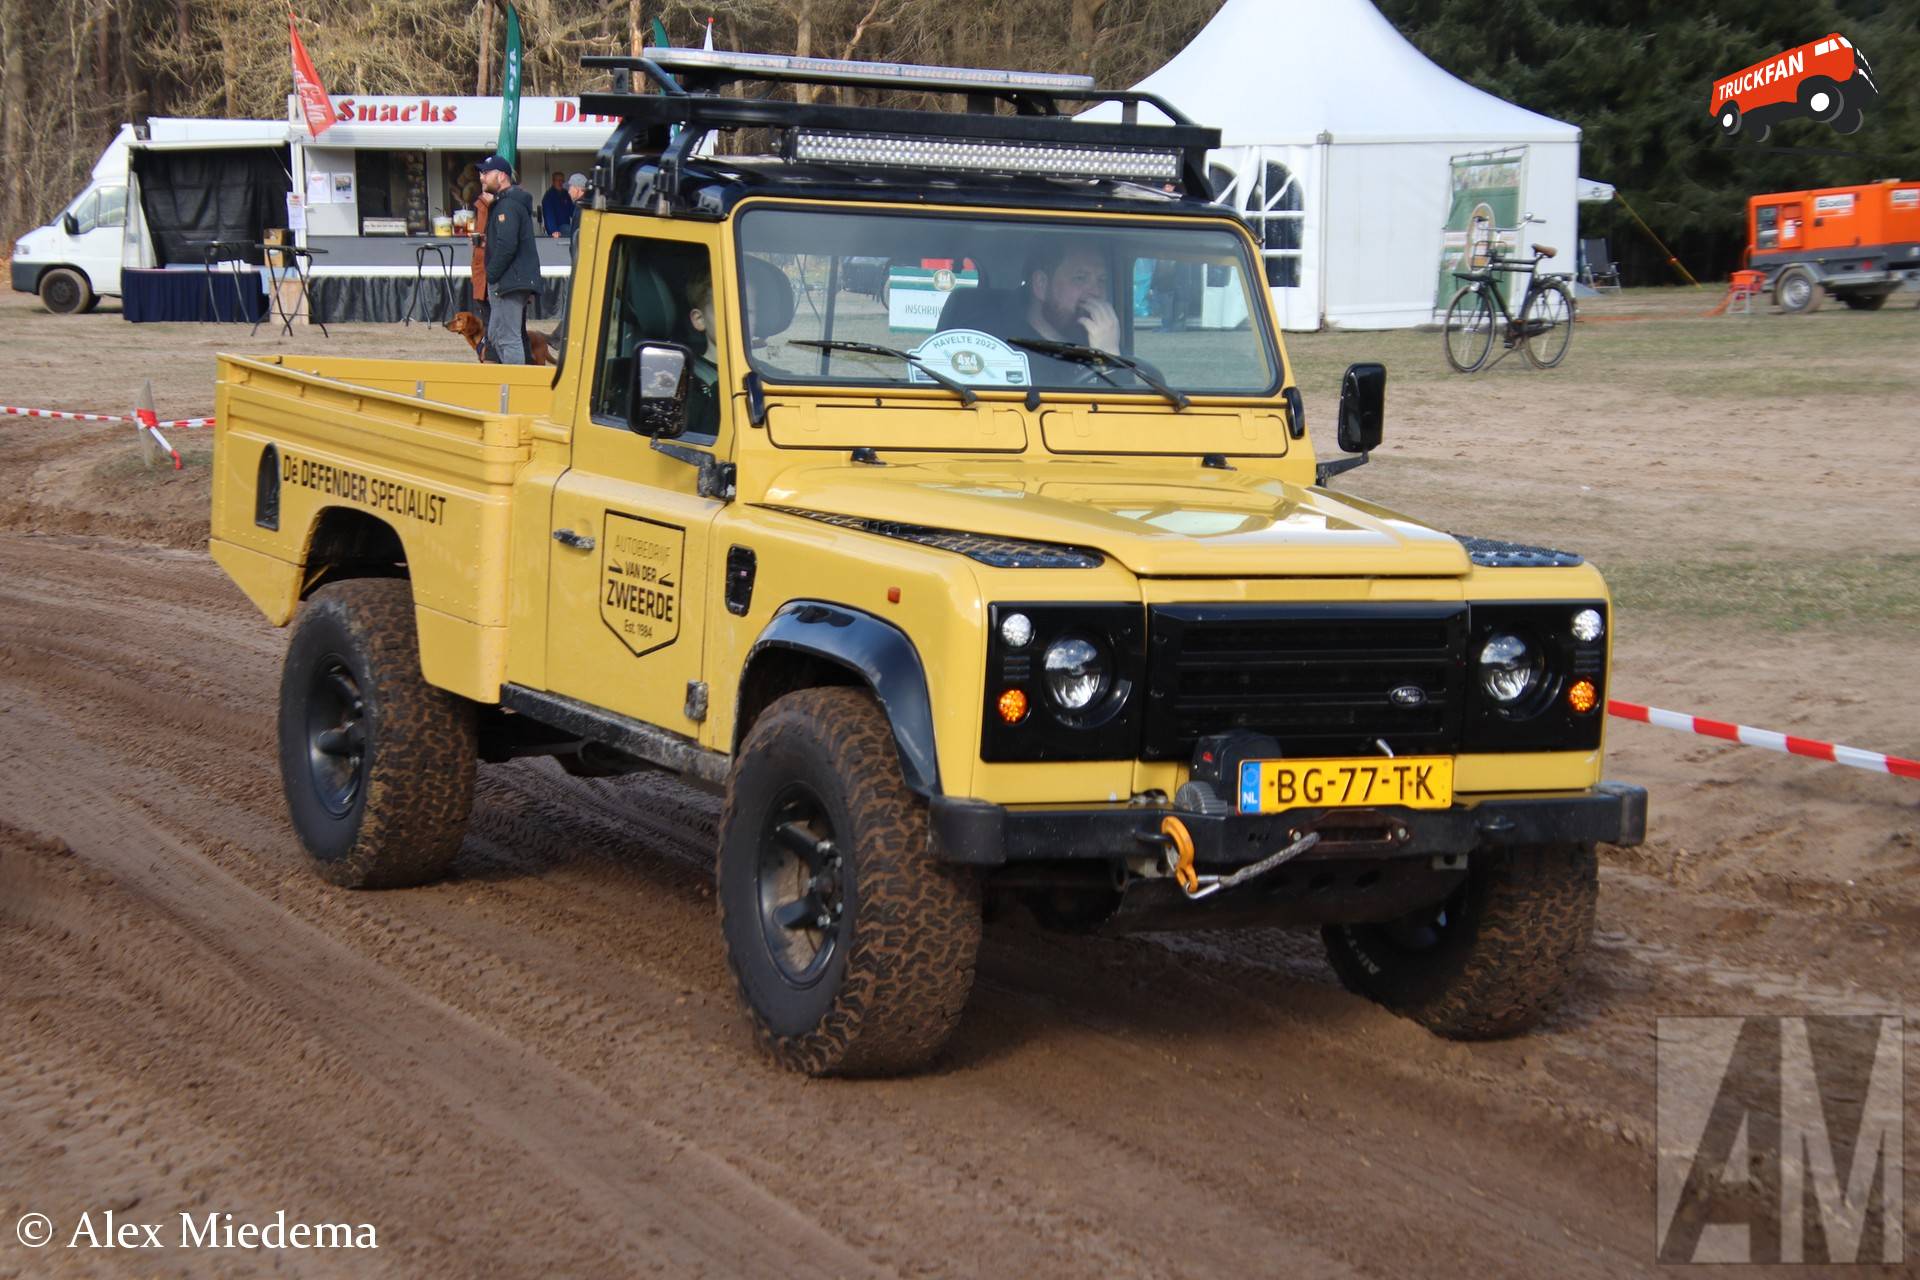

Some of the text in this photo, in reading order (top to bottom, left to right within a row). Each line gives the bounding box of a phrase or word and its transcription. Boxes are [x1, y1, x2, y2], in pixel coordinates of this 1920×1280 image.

[337, 99, 457, 122] Snacks
[933, 335, 998, 350] HAVELTE 2022
[957, 354, 977, 366] 4x4
[302, 460, 367, 504] DEFENDER
[371, 478, 446, 526] SPECIALIST
[625, 561, 657, 583] VAN DER
[606, 579, 673, 622] ZWEERDE
[1276, 765, 1435, 804] BG-77-TK
[1243, 790, 1258, 804] NL
